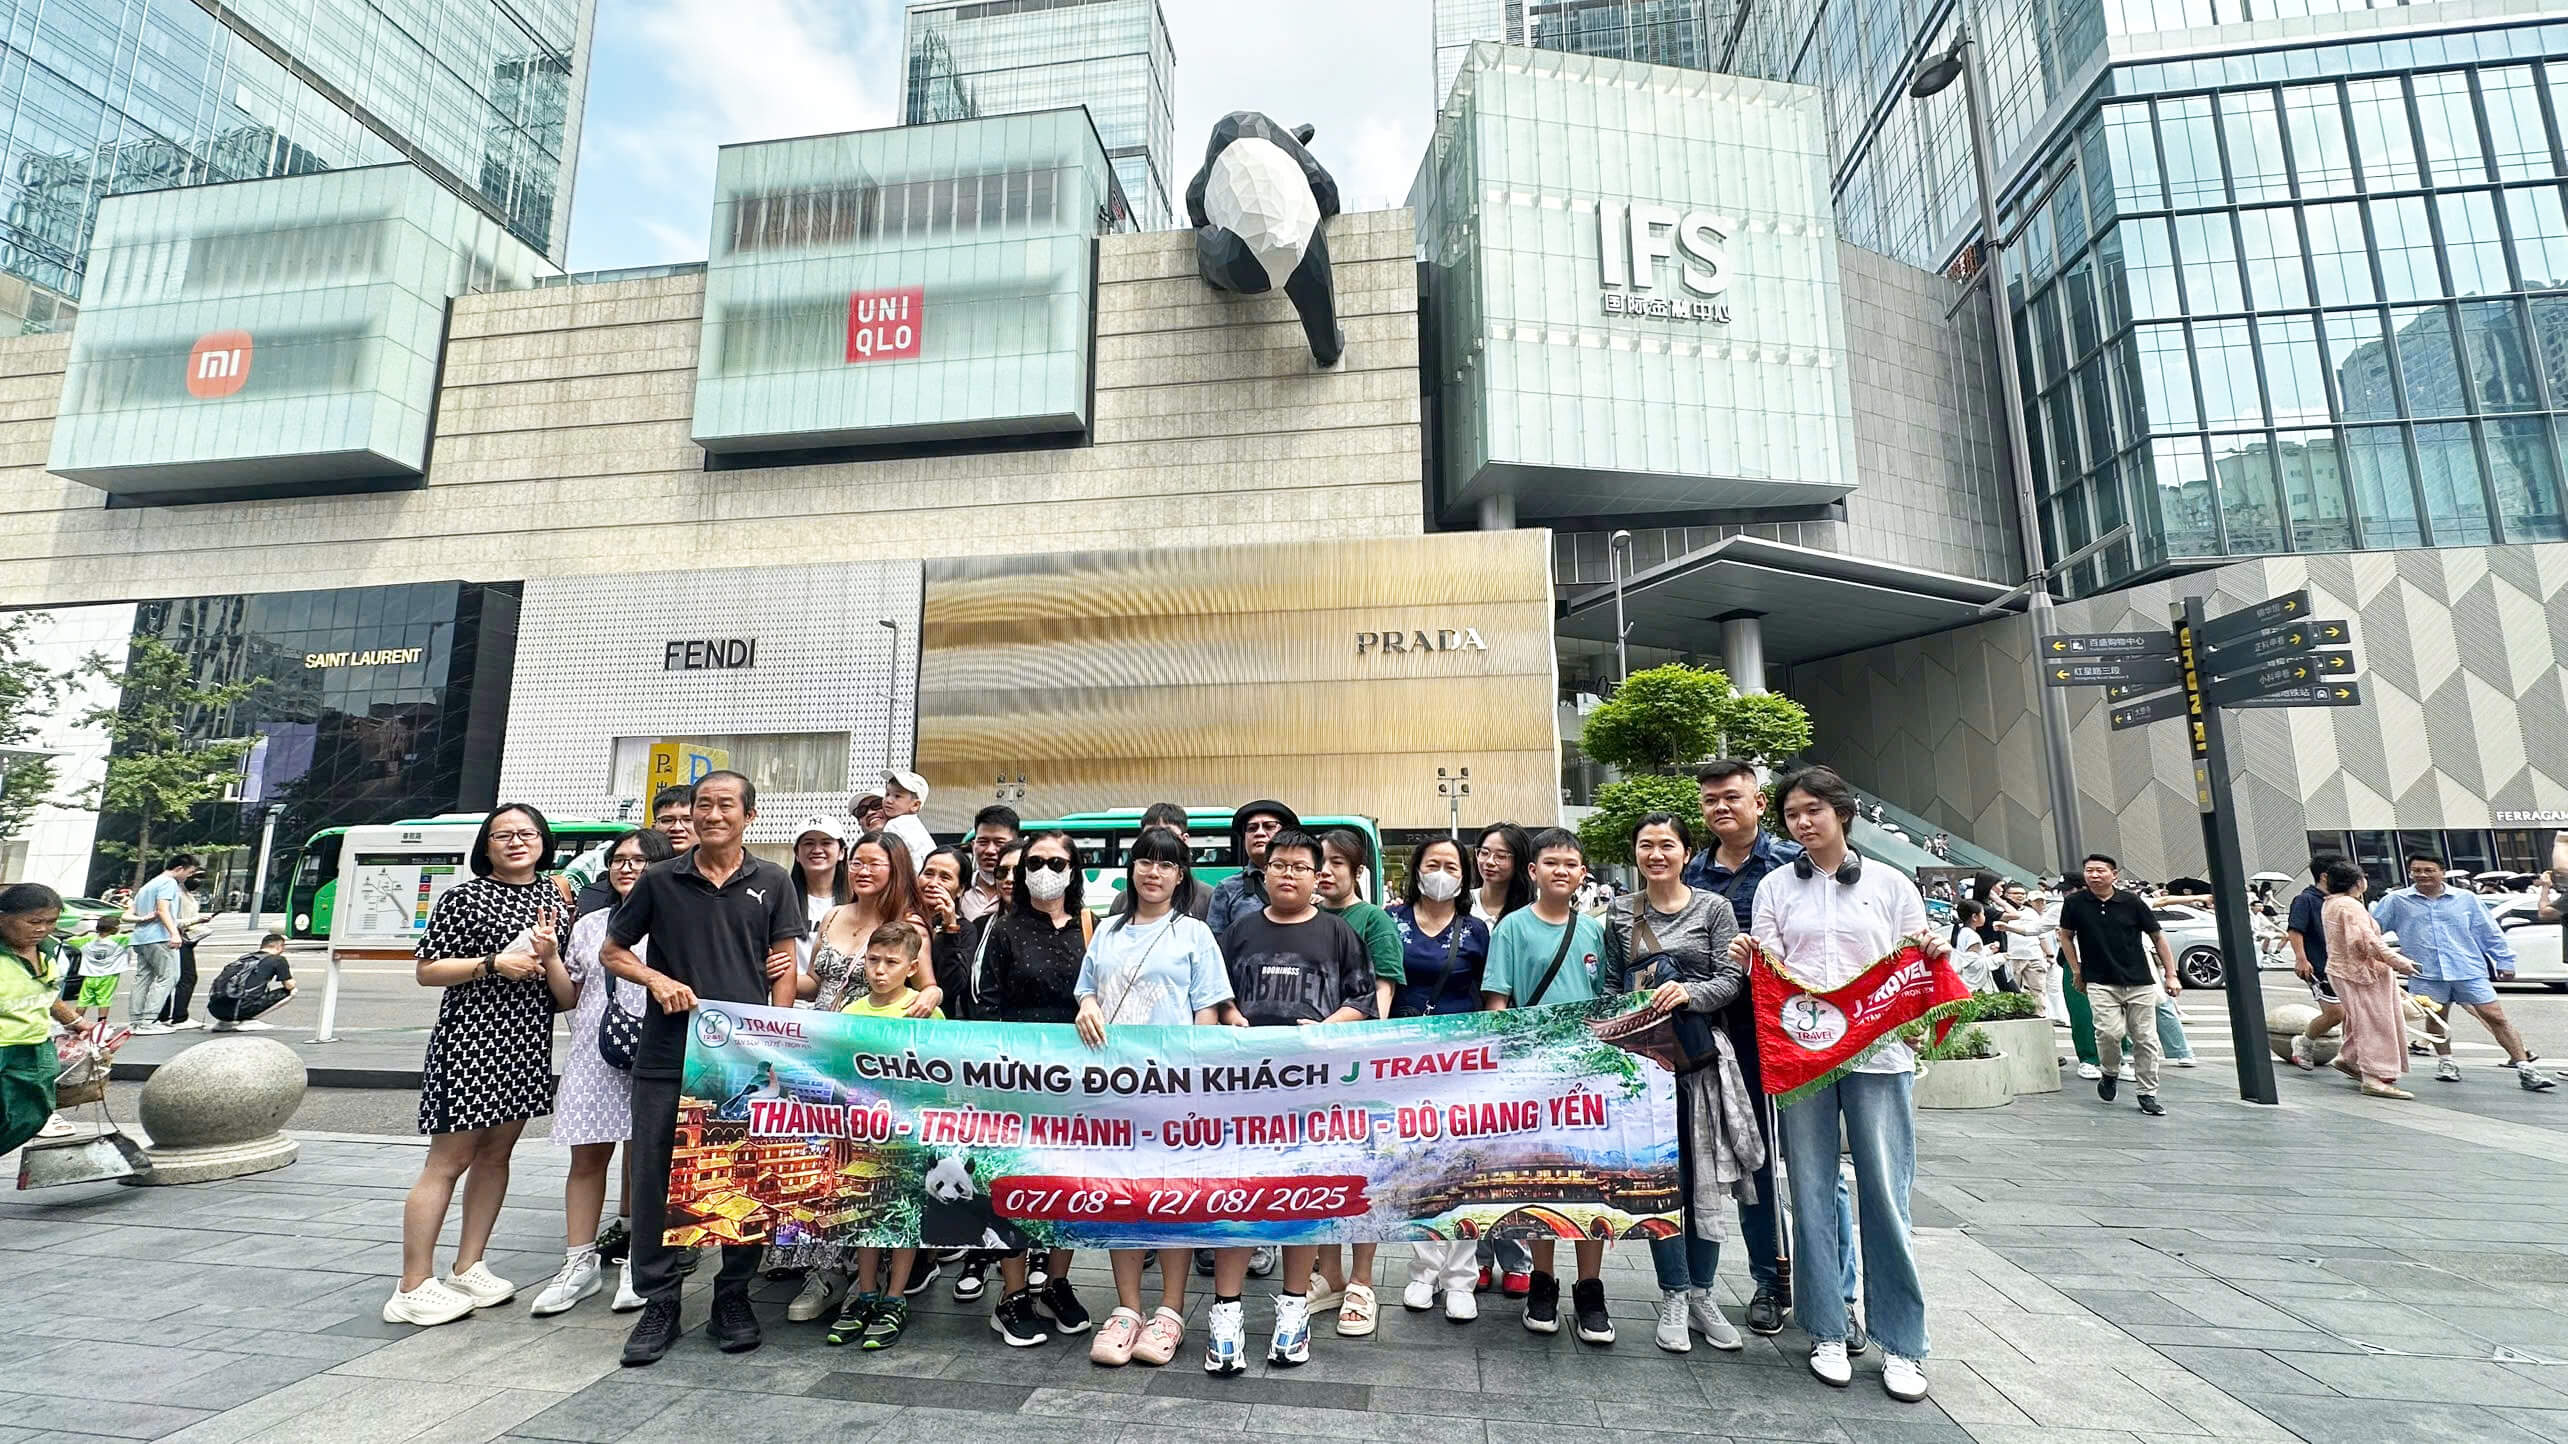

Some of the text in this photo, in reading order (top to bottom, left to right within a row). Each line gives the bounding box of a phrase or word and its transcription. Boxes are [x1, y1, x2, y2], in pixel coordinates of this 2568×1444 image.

[1596, 199, 1729, 297] IFS
[858, 296, 908, 323] UNI
[1601, 292, 1731, 325] 国际金融中心
[856, 325, 912, 356] QLO
[665, 639, 756, 670] FENDI
[1356, 627, 1487, 654] PRADA
[305, 648, 423, 669] SAINT LAURENT
[655, 754, 671, 773] P
[1867, 959, 1933, 1006] TRAVEL
[1797, 1031, 1835, 1041] TRAVEL
[856, 1046, 1498, 1094] CHÀO MỪNG ĐOÀN KHÁCH J TRAVEL
[750, 1096, 843, 1136] THÀNH
[850, 1101, 889, 1141] ĐÔ
[921, 1104, 1021, 1144] TRÙNG
[1029, 1112, 1132, 1146] KHÁNH
[1163, 1112, 1222, 1146] CỬU
[1231, 1113, 1296, 1151] TRẠI
[1307, 1104, 1366, 1142] CÂU
[1398, 1099, 1438, 1138] ĐÔ
[1448, 1100, 1538, 1137] GIANG
[1548, 1083, 1605, 1126] YỂN
[1005, 1189, 1063, 1213] 07/
[1068, 1190, 1108, 1214] 08
[1267, 1185, 1350, 1212] 2025
